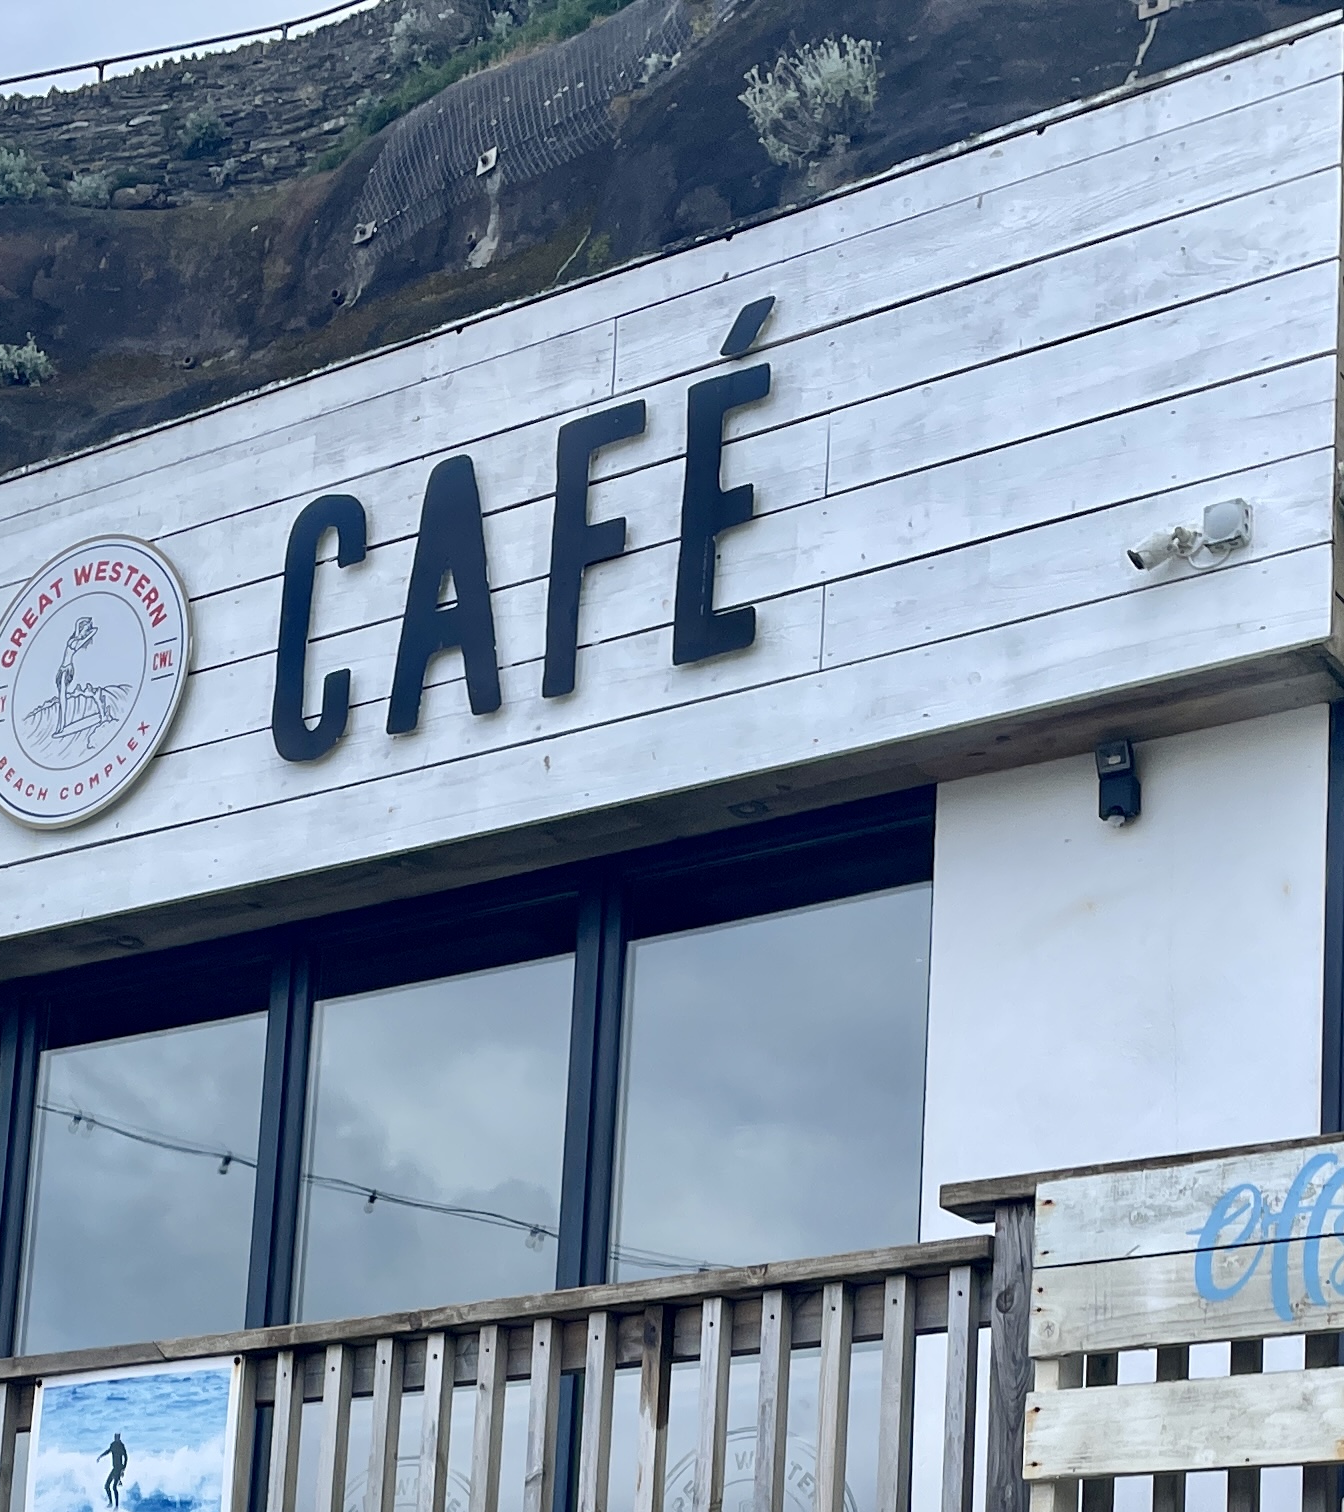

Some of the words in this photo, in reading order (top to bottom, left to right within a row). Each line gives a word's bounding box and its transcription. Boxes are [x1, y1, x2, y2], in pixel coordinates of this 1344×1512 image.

[272, 295, 775, 762] CAFÉ
[1, 578, 63, 669] GREAT
[74, 560, 167, 628] WESTERN
[152, 649, 173, 671] CWL
[60, 721, 150, 800] COMPLEX
